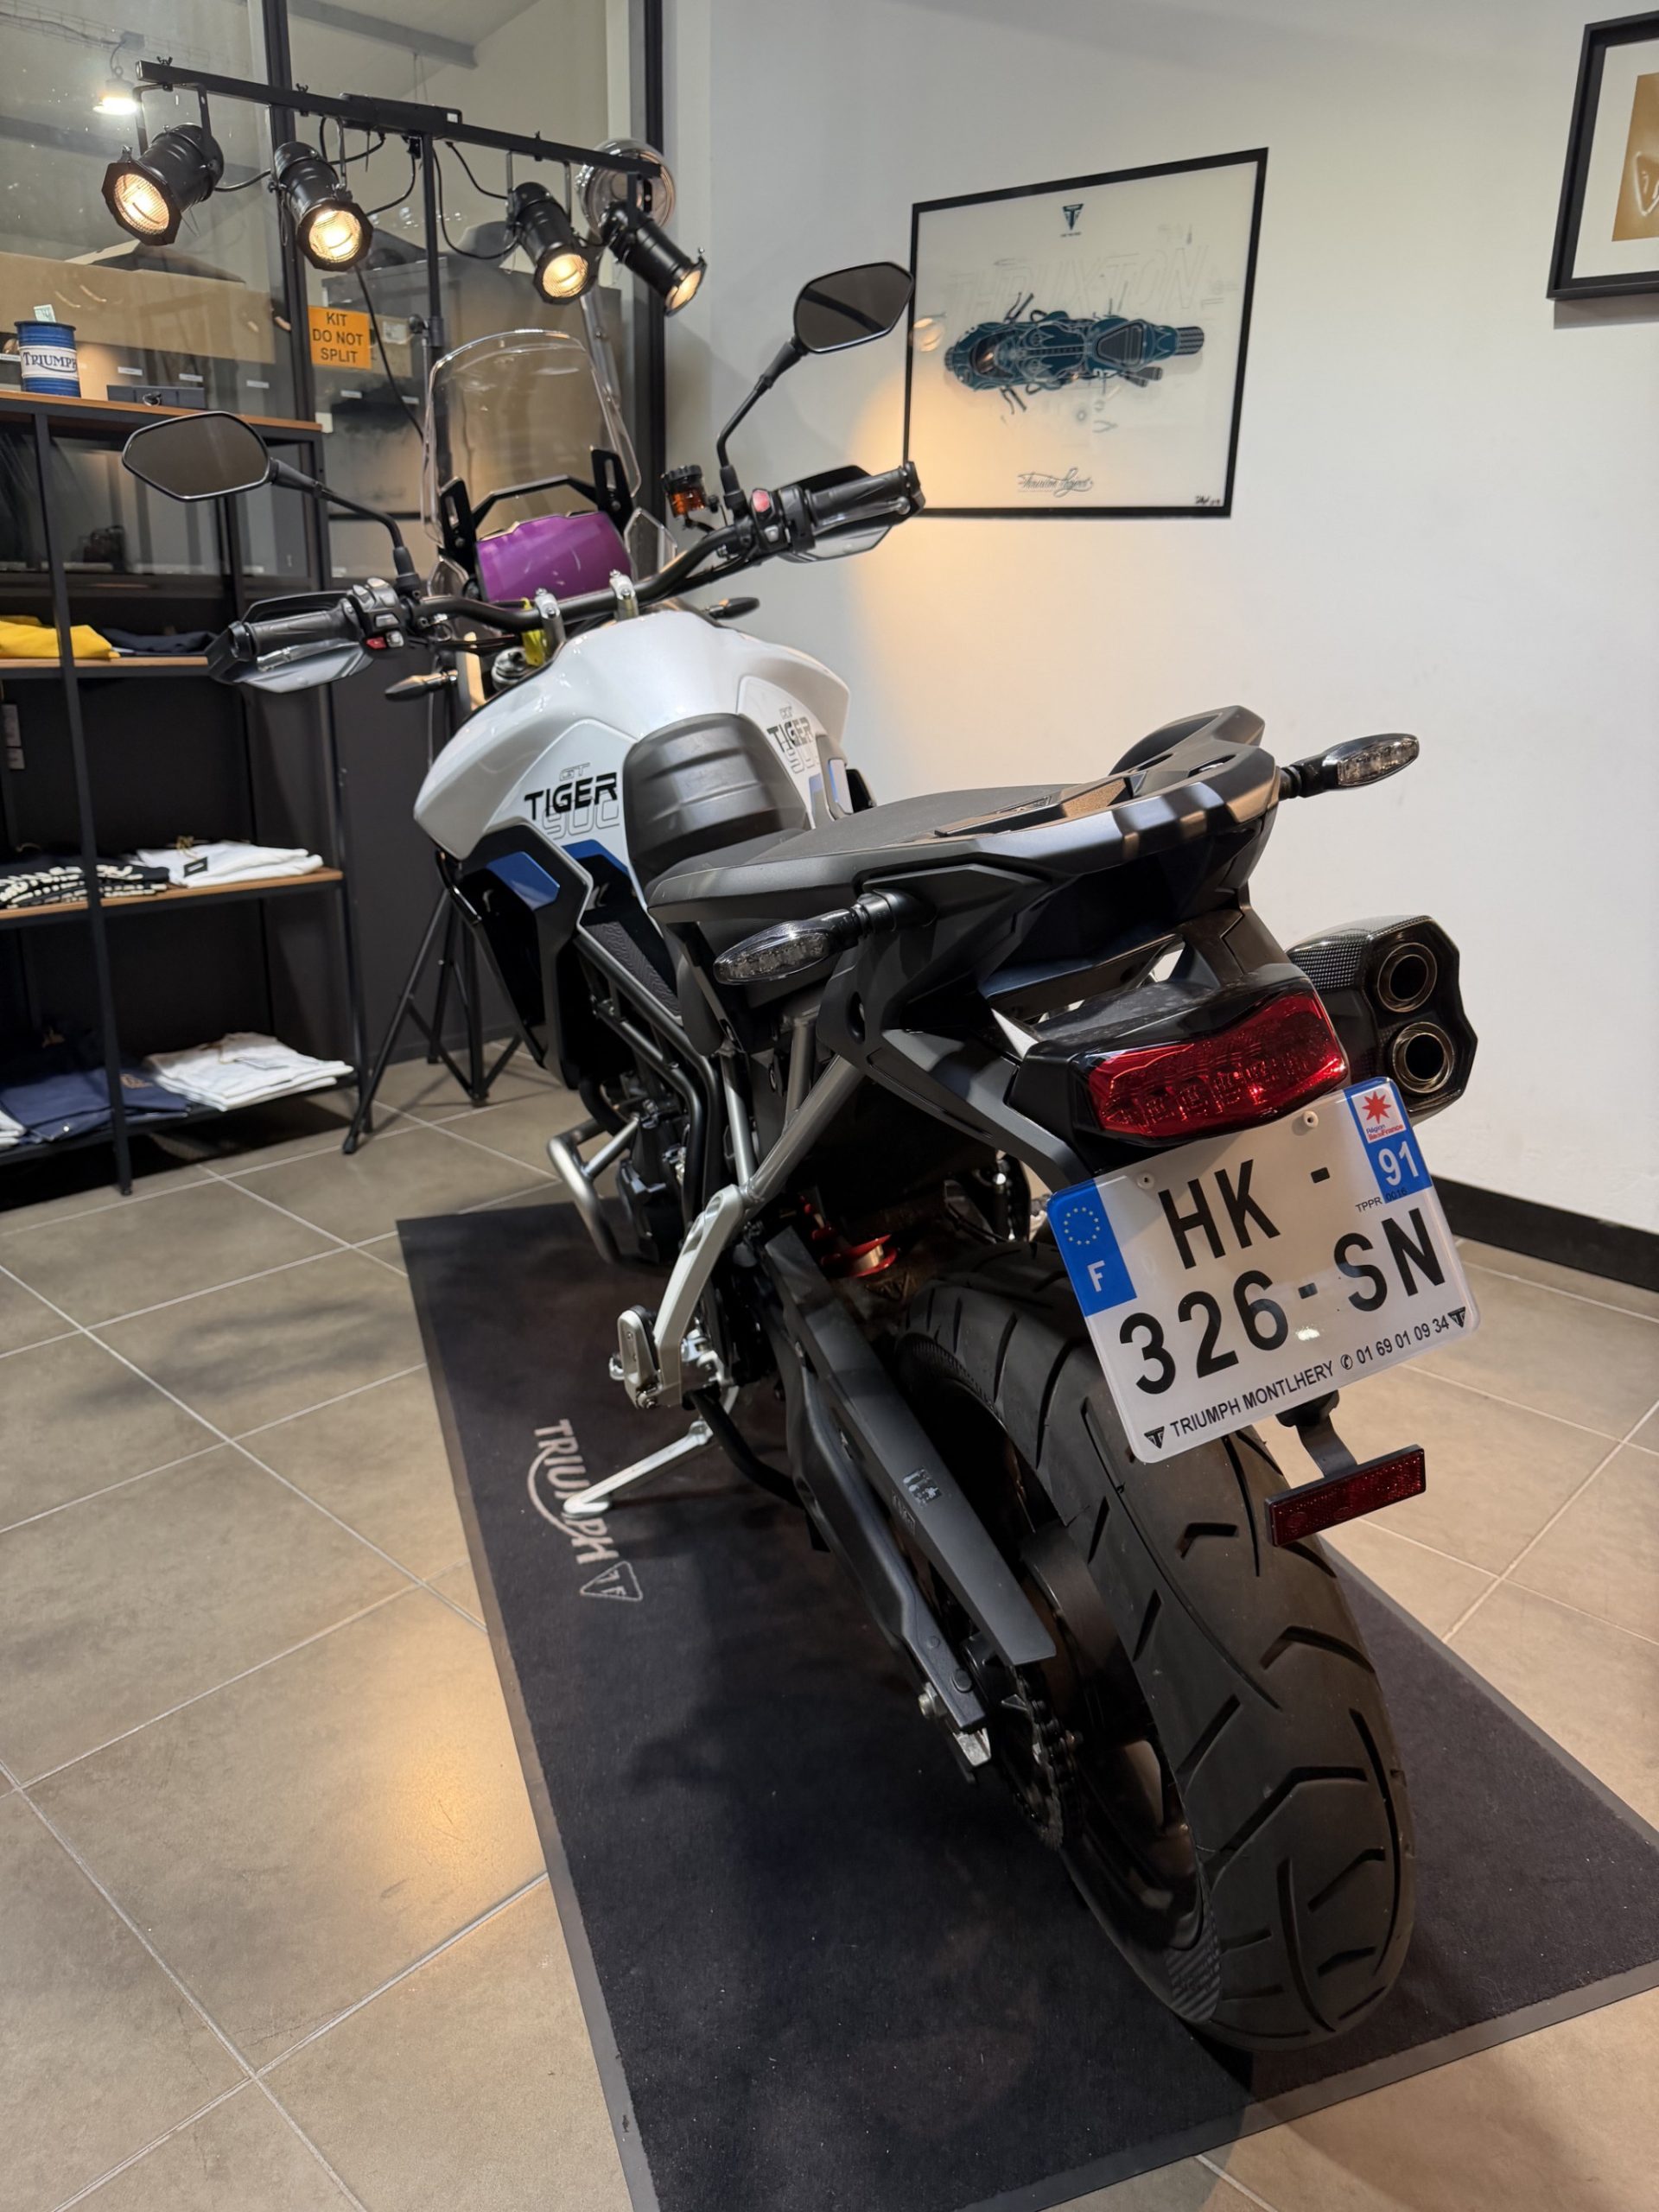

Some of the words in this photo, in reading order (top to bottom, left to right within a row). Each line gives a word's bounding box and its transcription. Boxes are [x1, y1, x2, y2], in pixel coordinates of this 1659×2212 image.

[326, 312, 347, 327] KIT
[312, 328, 333, 342] DO
[336, 331, 363, 346] NOT
[321, 347, 358, 363] SPLIT
[766, 716, 814, 753] TIGER
[559, 763, 590, 781] GT
[524, 772, 618, 821] TIGER
[1378, 1141, 1419, 1186] 91
[1158, 1159, 1281, 1269] HK
[1355, 1197, 1382, 1213] TPPR
[1087, 1260, 1106, 1293] F
[1170, 1398, 1241, 1438] TRIUMPH
[1243, 1360, 1333, 1411] MONTLHERY
[1357, 1345, 1373, 1364] 01
[1376, 1338, 1393, 1357] 69
[1395, 1330, 1411, 1349] 01
[1414, 1323, 1431, 1341] 09
[1432, 1315, 1450, 1333] 34
